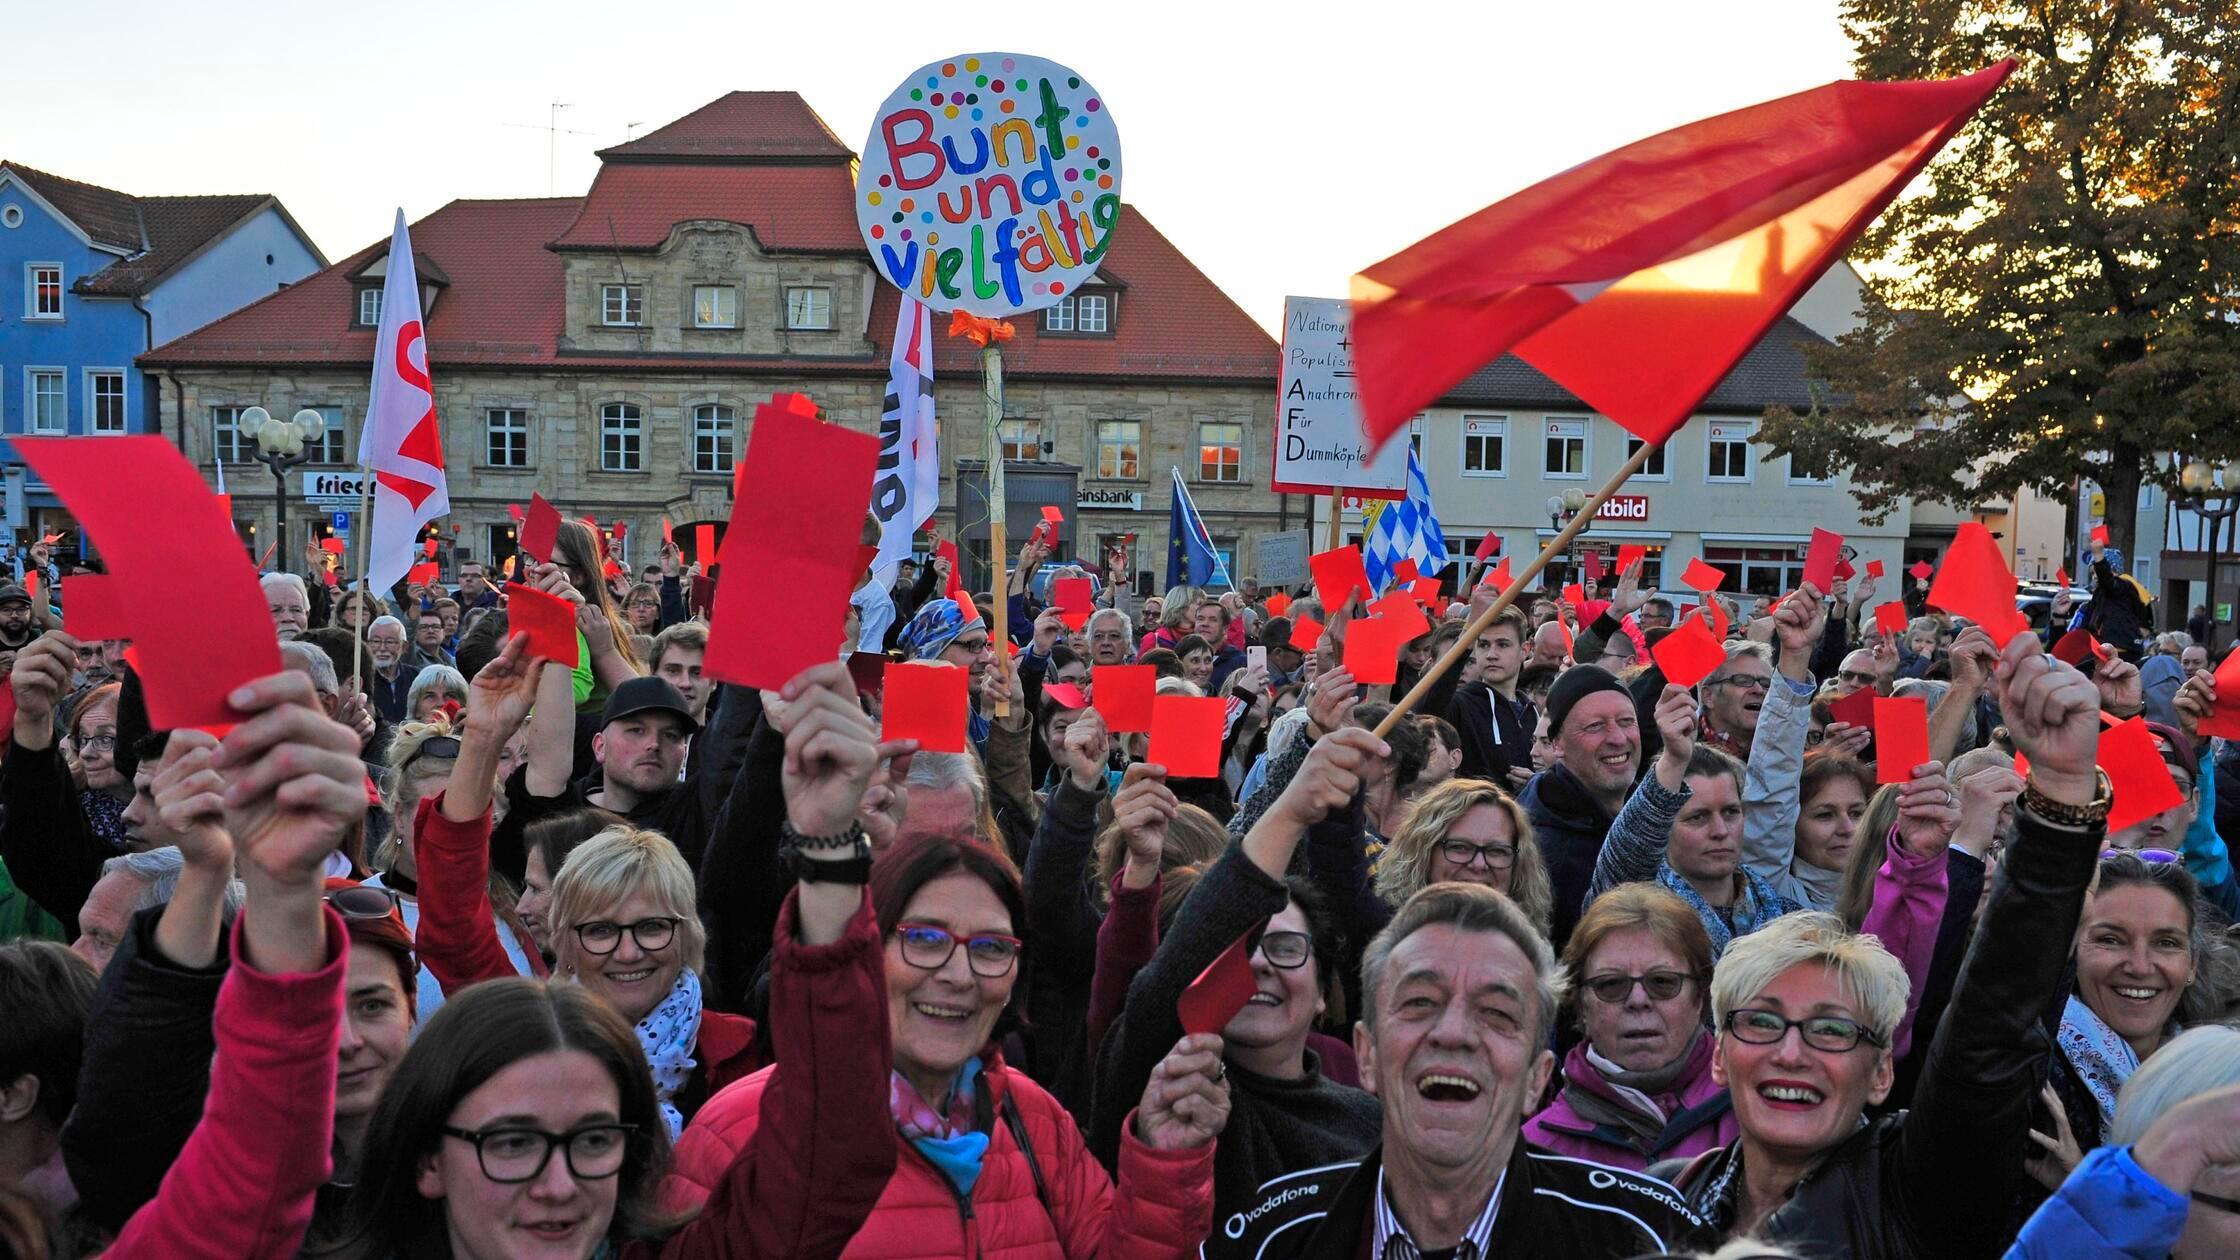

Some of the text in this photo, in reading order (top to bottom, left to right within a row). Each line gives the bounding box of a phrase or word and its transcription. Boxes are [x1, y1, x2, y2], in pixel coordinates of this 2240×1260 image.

[881, 77, 1066, 191] Bunt
[937, 144, 1062, 224] und
[1287, 407, 1313, 430] Für
[336, 514, 346, 528] P
[1245, 1184, 1320, 1224] vodafone
[1618, 1179, 1702, 1227] vodafone
